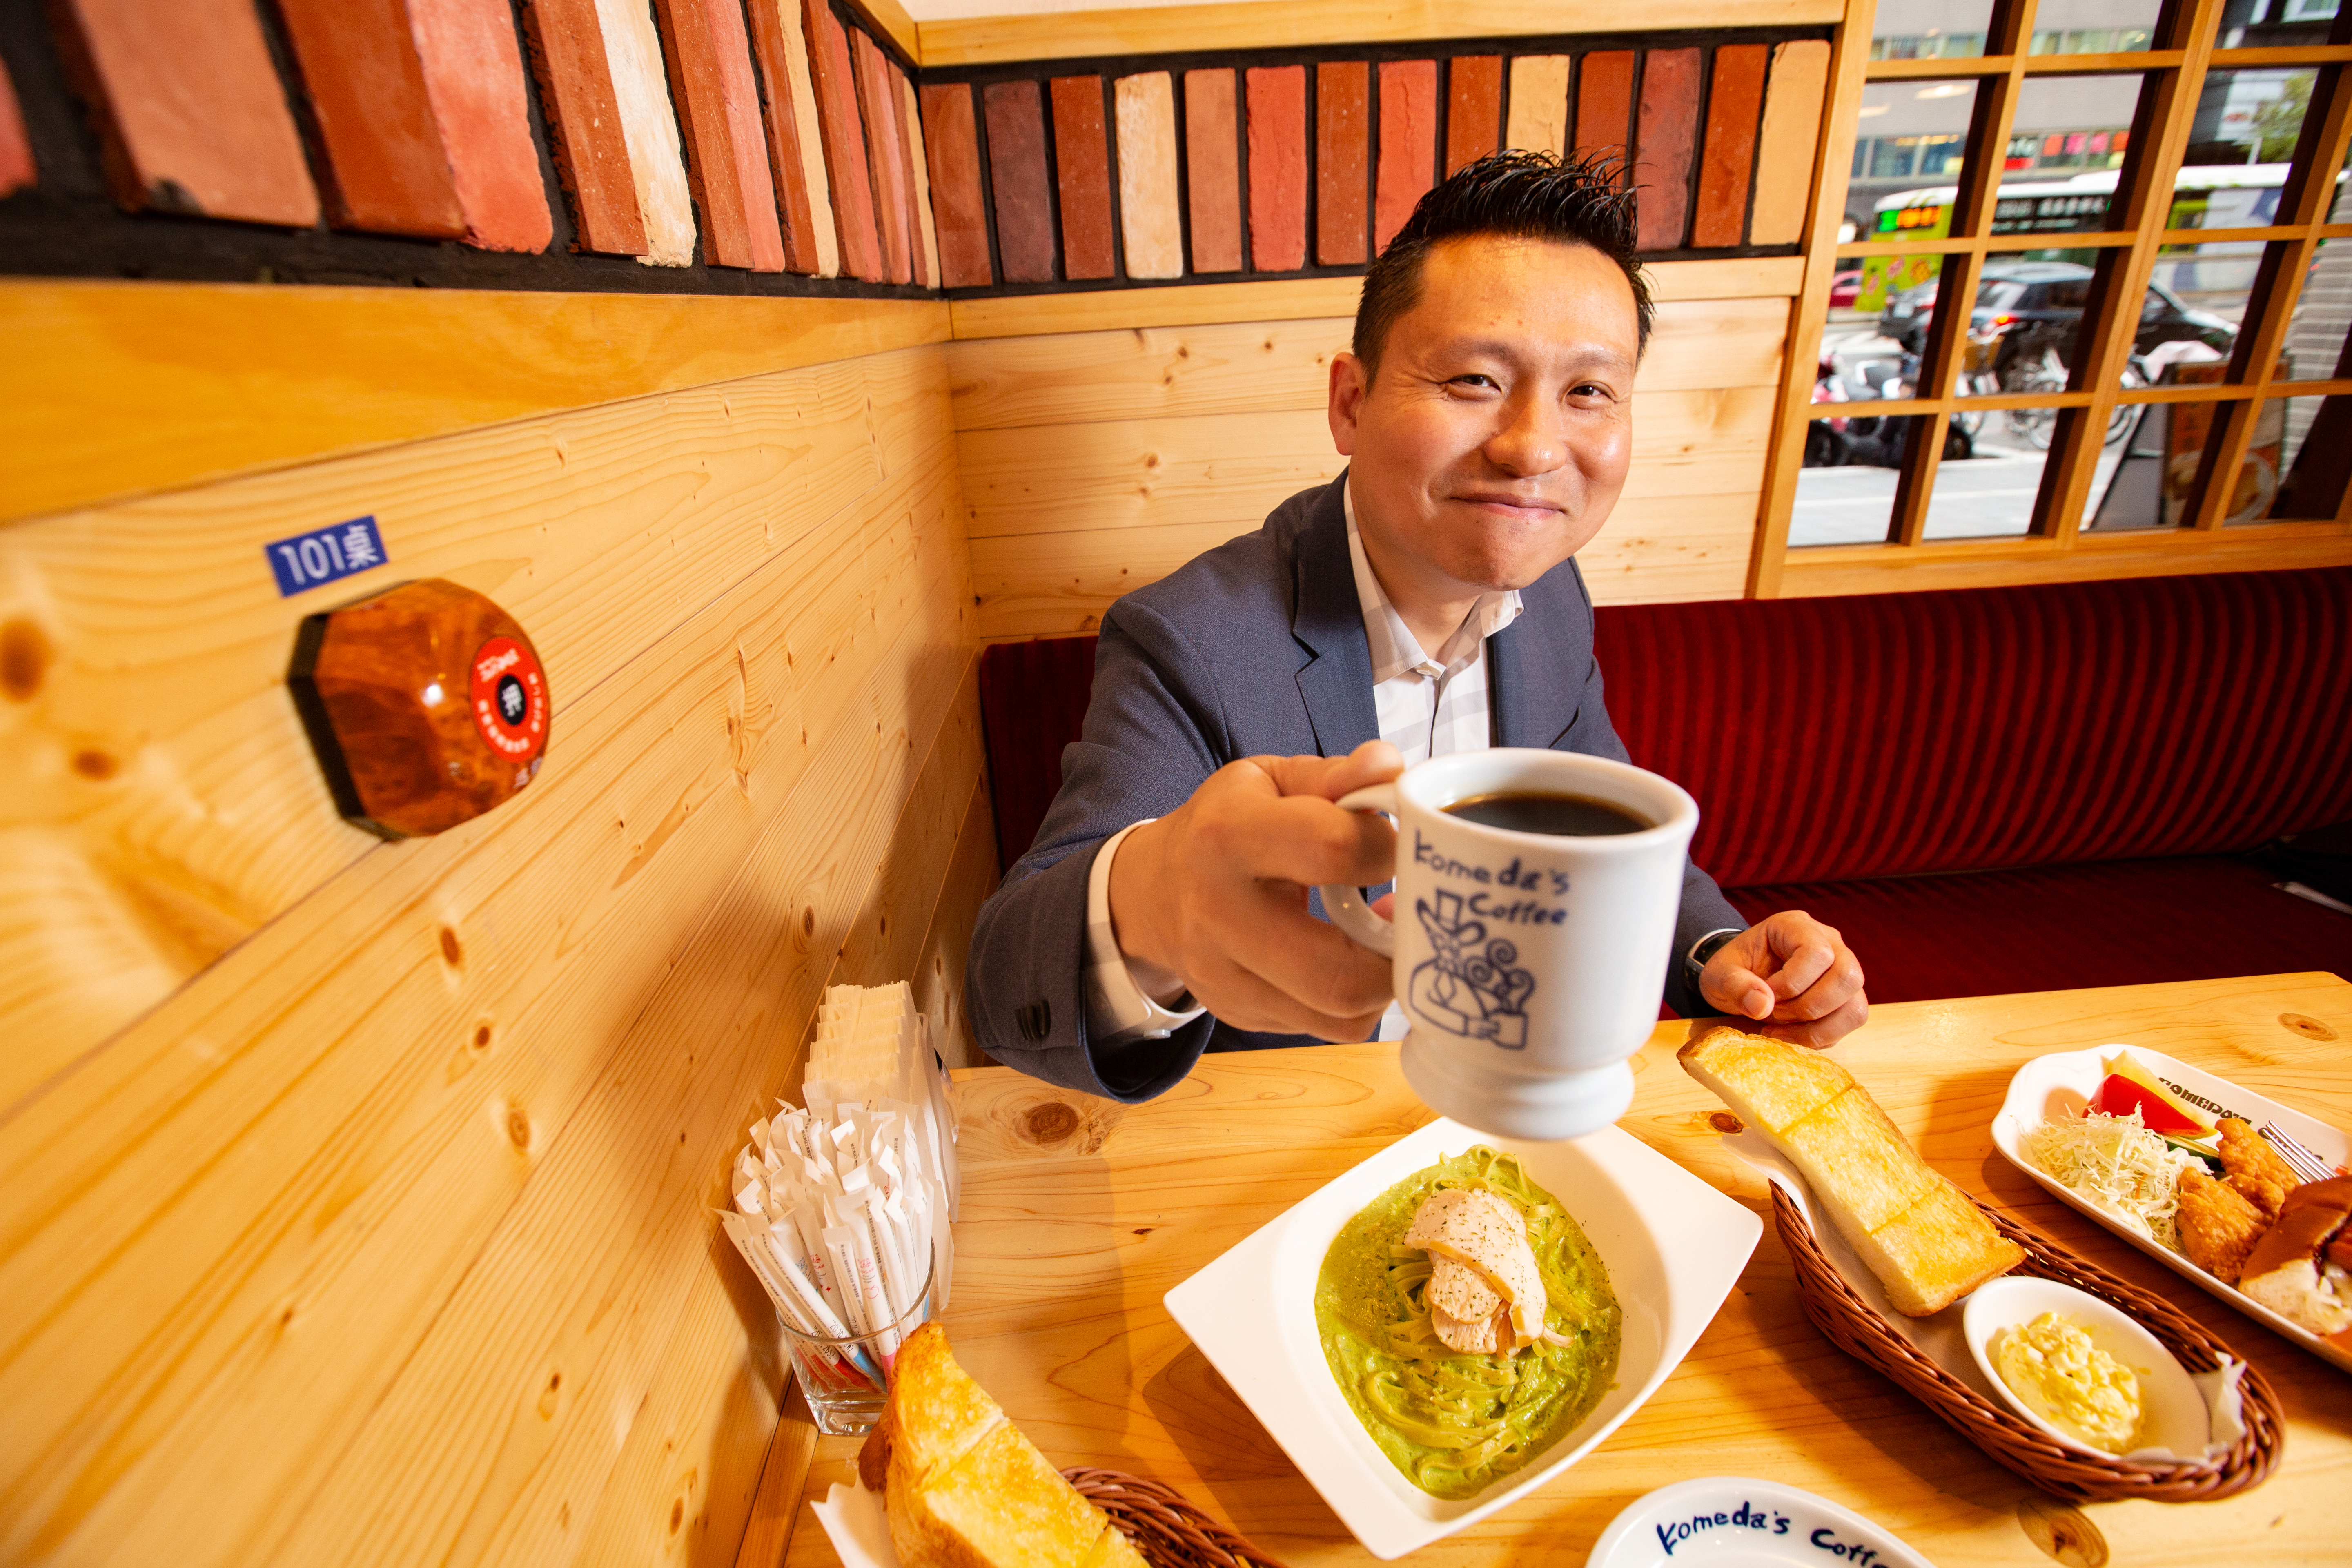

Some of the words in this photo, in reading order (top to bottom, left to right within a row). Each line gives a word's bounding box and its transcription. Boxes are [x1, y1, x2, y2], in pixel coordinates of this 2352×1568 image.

[1414, 828, 1571, 896] Komeda's
[1468, 892, 1568, 926] Coffee
[1657, 1501, 1791, 1555] Komeda's
[1810, 1528, 1890, 1568] Coff
